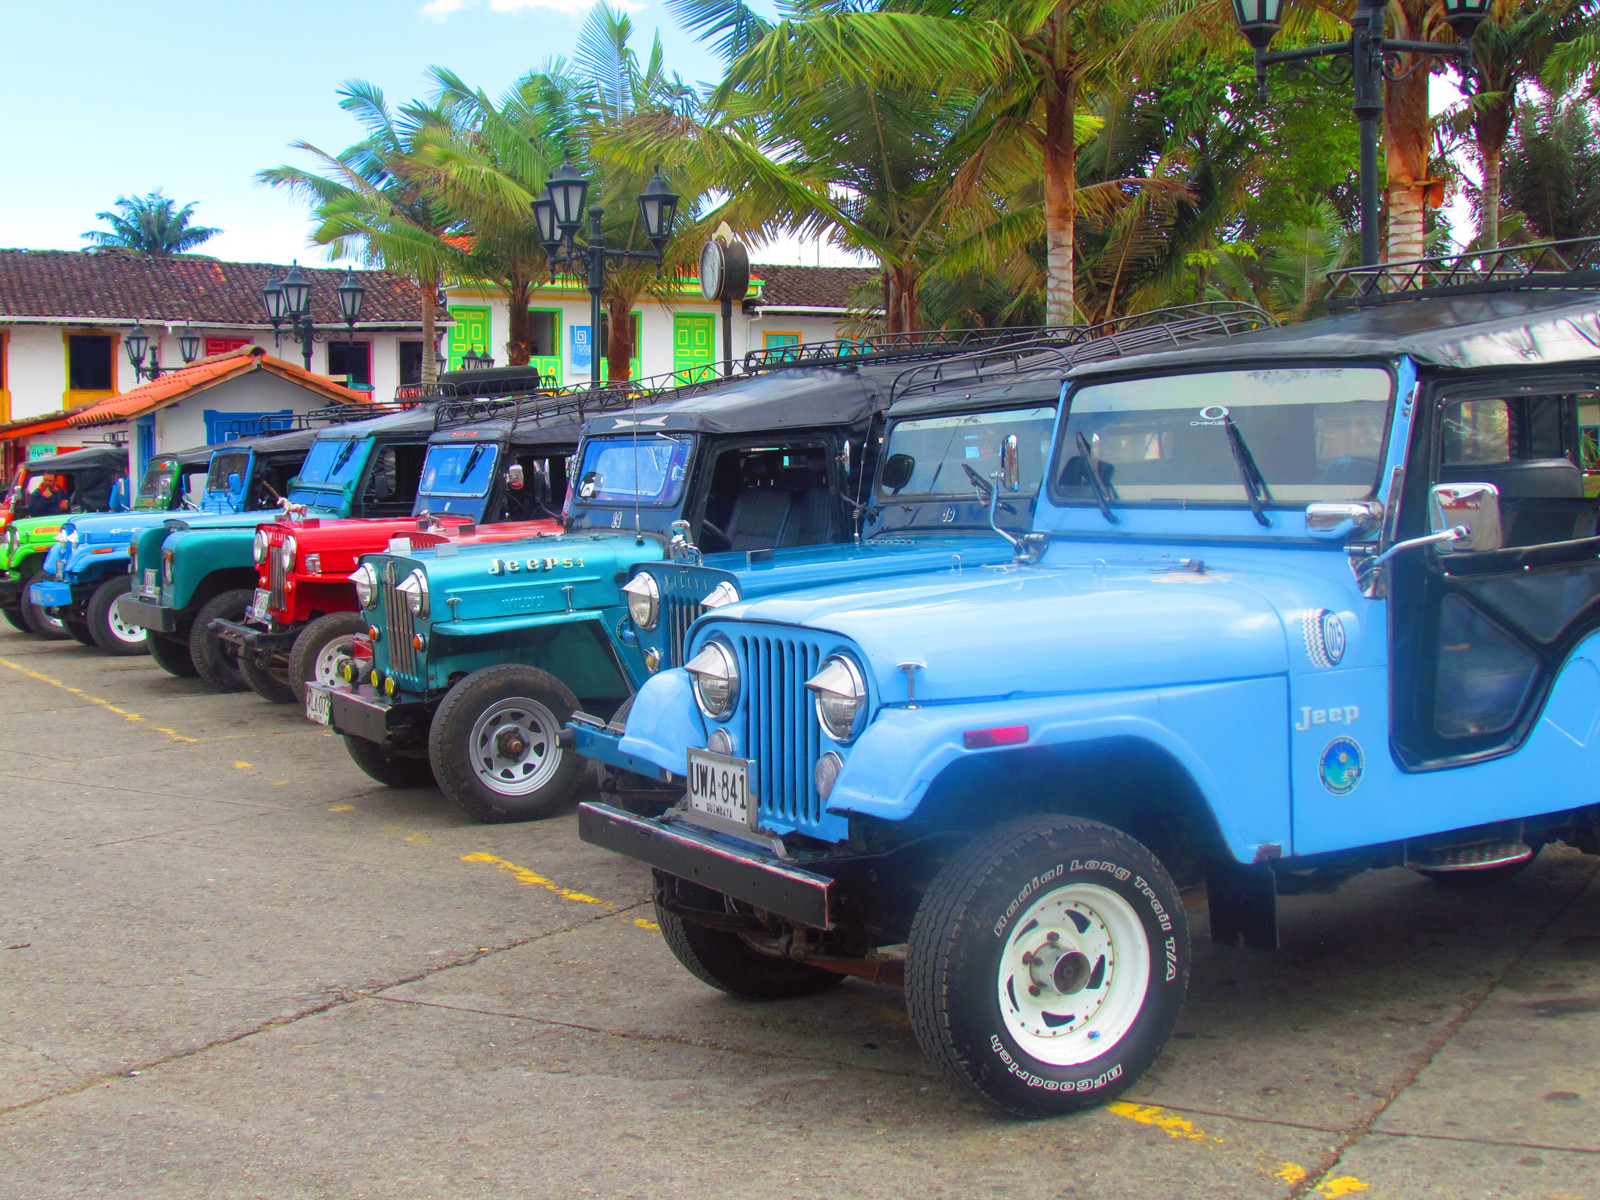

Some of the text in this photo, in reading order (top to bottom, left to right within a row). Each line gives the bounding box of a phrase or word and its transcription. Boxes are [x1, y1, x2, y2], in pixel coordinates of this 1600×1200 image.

[488, 557, 559, 575] Jeep
[1294, 706, 1360, 731] Jeep
[994, 860, 1178, 981] Radial Long Trail T/A
[990, 1034, 1123, 1093] BFGoodrich
